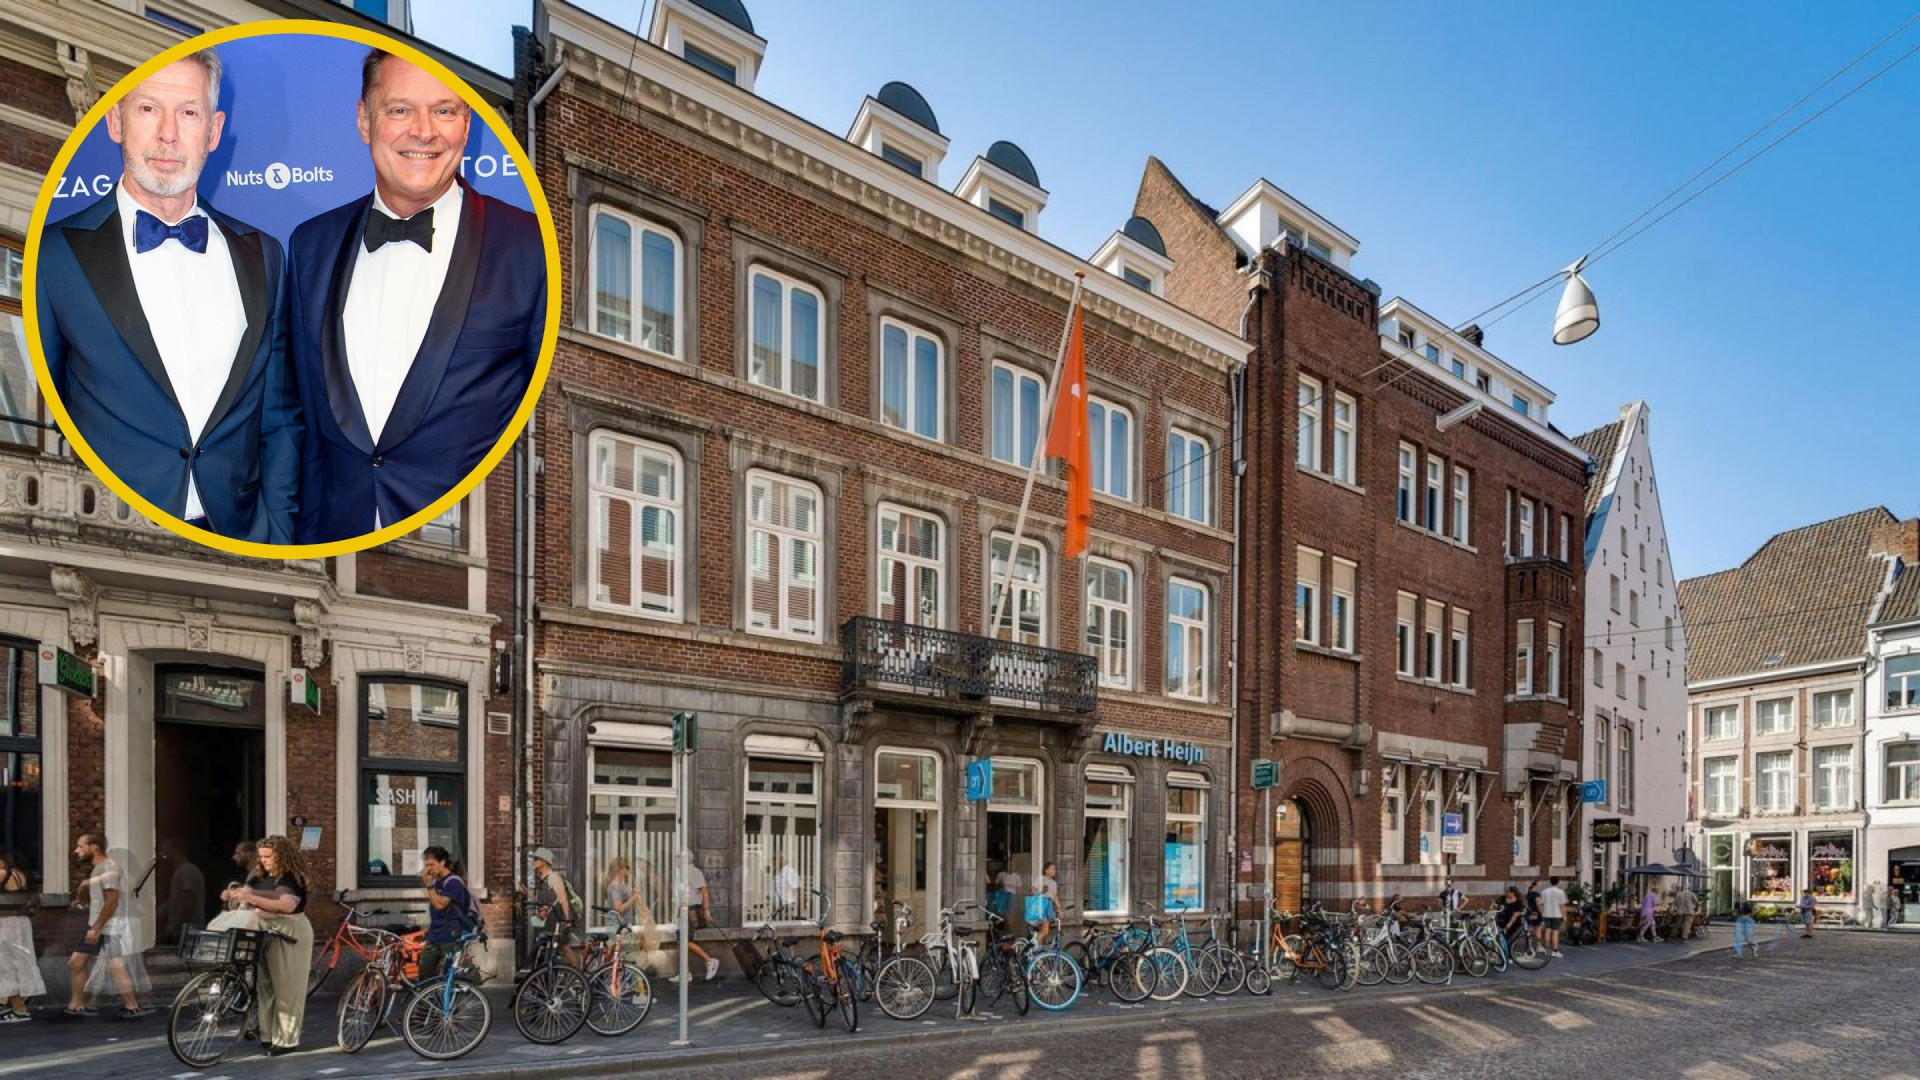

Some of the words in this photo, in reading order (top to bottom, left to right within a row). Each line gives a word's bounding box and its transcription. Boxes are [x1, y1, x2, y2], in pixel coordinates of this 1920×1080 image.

[53, 174, 113, 198] ZAG
[226, 170, 264, 187] Nuts
[292, 166, 334, 183] Bolts
[1103, 732, 1159, 757] Albert
[1163, 739, 1203, 765] Heijn
